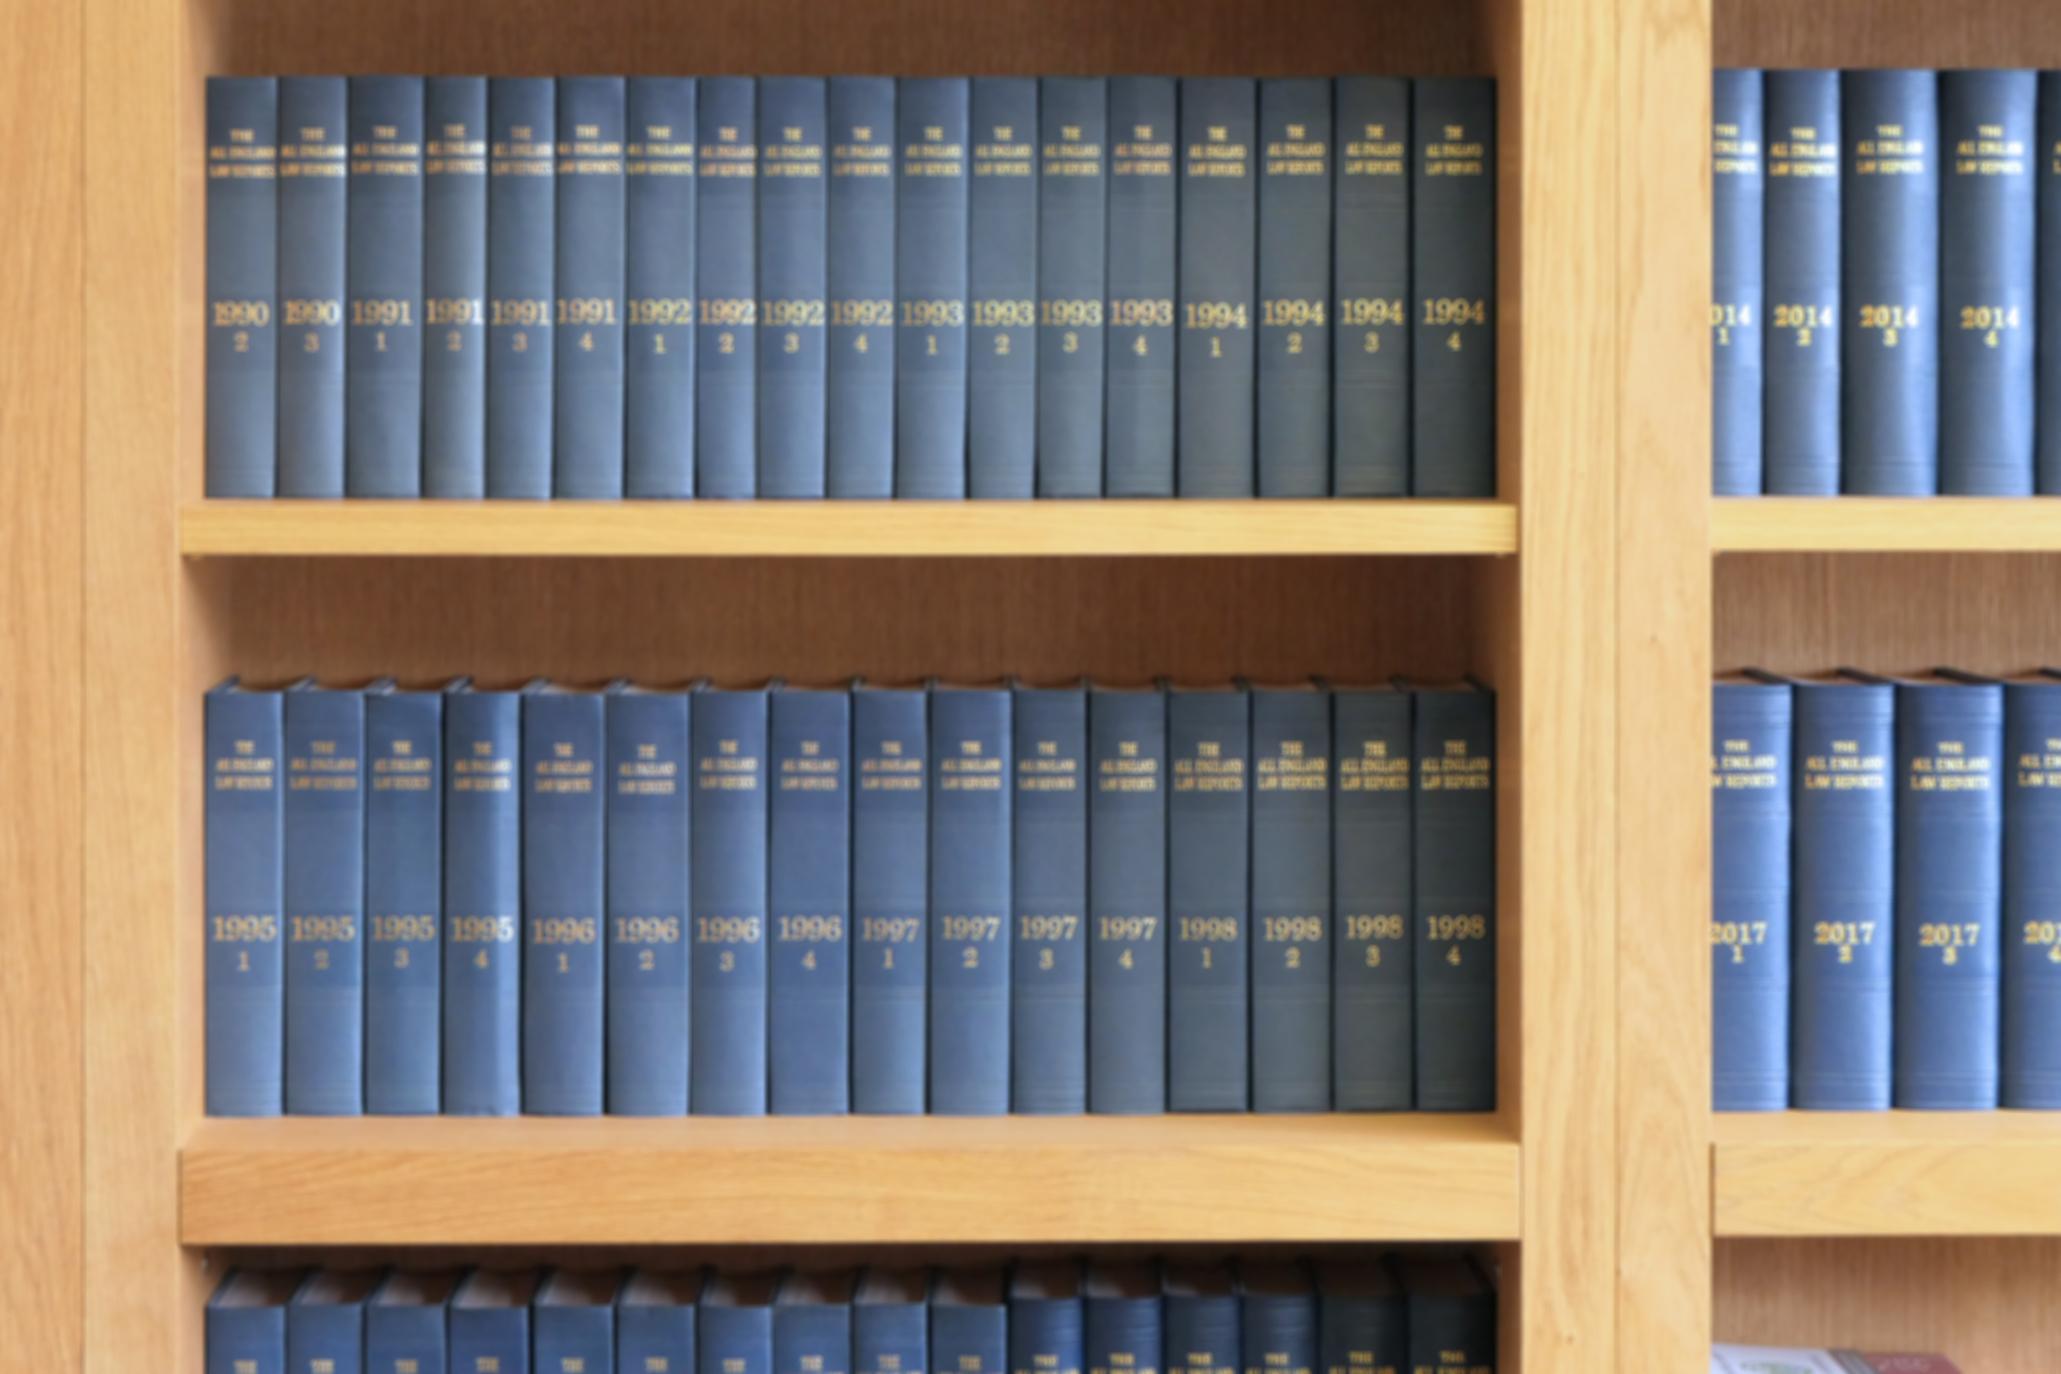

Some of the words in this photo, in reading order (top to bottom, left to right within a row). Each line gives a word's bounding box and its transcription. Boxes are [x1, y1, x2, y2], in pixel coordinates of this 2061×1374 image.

[214, 302, 270, 326] 1990
[285, 300, 341, 325] 1990
[354, 300, 412, 325] 1991
[427, 299, 485, 325] 1991
[491, 300, 551, 326] 1991
[556, 299, 617, 324] 1991
[629, 299, 692, 324] 1992
[699, 299, 756, 325] 1992
[764, 300, 825, 326] 1992
[833, 300, 893, 326] 1992
[904, 300, 964, 326] 1993
[974, 300, 1035, 326] 1993
[1042, 300, 1102, 326] 1993
[1112, 299, 1173, 326] 1993
[1187, 302, 1248, 328] 1994
[1265, 300, 1324, 326] 1994
[1343, 299, 1403, 324] 1994
[1424, 298, 1484, 324] 1994
[1711, 304, 1751, 327] 014
[1774, 304, 1834, 328] 2014
[1860, 304, 1919, 328] 2014
[1961, 306, 2020, 329] 2014
[234, 332, 249, 351] 2
[305, 335, 320, 350] 3
[376, 333, 387, 350] 1
[447, 333, 462, 350] 2
[512, 333, 528, 350] 3
[580, 334, 593, 349] 4
[655, 335, 666, 353] 1
[719, 334, 734, 352] 2
[784, 334, 799, 352] 3
[854, 335, 868, 352] 4
[927, 336, 938, 354] 1
[995, 335, 1010, 354] 2
[1063, 333, 1078, 352] 3
[1134, 337, 1147, 355] 4
[1288, 334, 1302, 353] 2
[1365, 333, 1379, 352] 3
[1447, 333, 1461, 350] 4
[1719, 328, 1729, 345] 1
[1797, 328, 1811, 346] 2
[1883, 327, 1898, 346] 3
[1984, 330, 1998, 346] 4
[1211, 339, 1222, 356] 1
[1724, 740, 1749, 752] THE
[1832, 741, 1857, 753] THE
[1938, 742, 1963, 754] THE
[1722, 756, 1776, 770] ENGLAND
[1807, 757, 1828, 771] ALL
[1831, 757, 1884, 771] ENGLAND
[1912, 758, 1932, 772] ALL
[1935, 758, 1990, 772] ENGLAND
[2020, 755, 2040, 768] ALL
[1727, 774, 1776, 788] REPORTS
[1805, 774, 1829, 789] LAW
[1833, 774, 1884, 789] REPORTS
[1911, 775, 1936, 790] LAW
[1940, 775, 1990, 790] REPORTS
[2019, 773, 2043, 787] LAW
[214, 915, 278, 941] 1995
[292, 916, 356, 941] 1995
[374, 915, 436, 941] 1995
[452, 916, 514, 942] 1995
[534, 918, 597, 944] 1996
[618, 917, 679, 943] 1996
[698, 917, 761, 942] 1996
[780, 916, 842, 941] 1996
[864, 918, 919, 941] 1997
[944, 917, 1000, 940] 1997
[1022, 916, 1078, 939] 1997
[1101, 917, 1157, 939] 1997
[1181, 918, 1237, 940] 1998
[1266, 917, 1322, 941] 1998
[1347, 915, 1402, 938] 1998
[1428, 915, 1485, 939] 1998
[1814, 922, 1875, 944] 2017
[1919, 924, 1980, 946] 2017
[238, 953, 249, 970] 1
[314, 951, 329, 968] 2
[394, 949, 410, 967] 3
[474, 952, 488, 967] 4
[558, 954, 570, 971] 1
[639, 951, 654, 969] 2
[720, 953, 734, 970] 3
[802, 953, 816, 968] 4
[884, 951, 893, 967] 1
[963, 948, 978, 967] 2
[1040, 950, 1053, 968] 3
[1119, 952, 1133, 968] 4
[1202, 950, 1211, 966] 1
[1286, 948, 1300, 967] 2
[1367, 946, 1380, 965] 3
[1447, 948, 1461, 965] 4
[1733, 945, 1744, 963] 1
[1838, 945, 1852, 963] 2
[1943, 945, 1957, 964] 3
